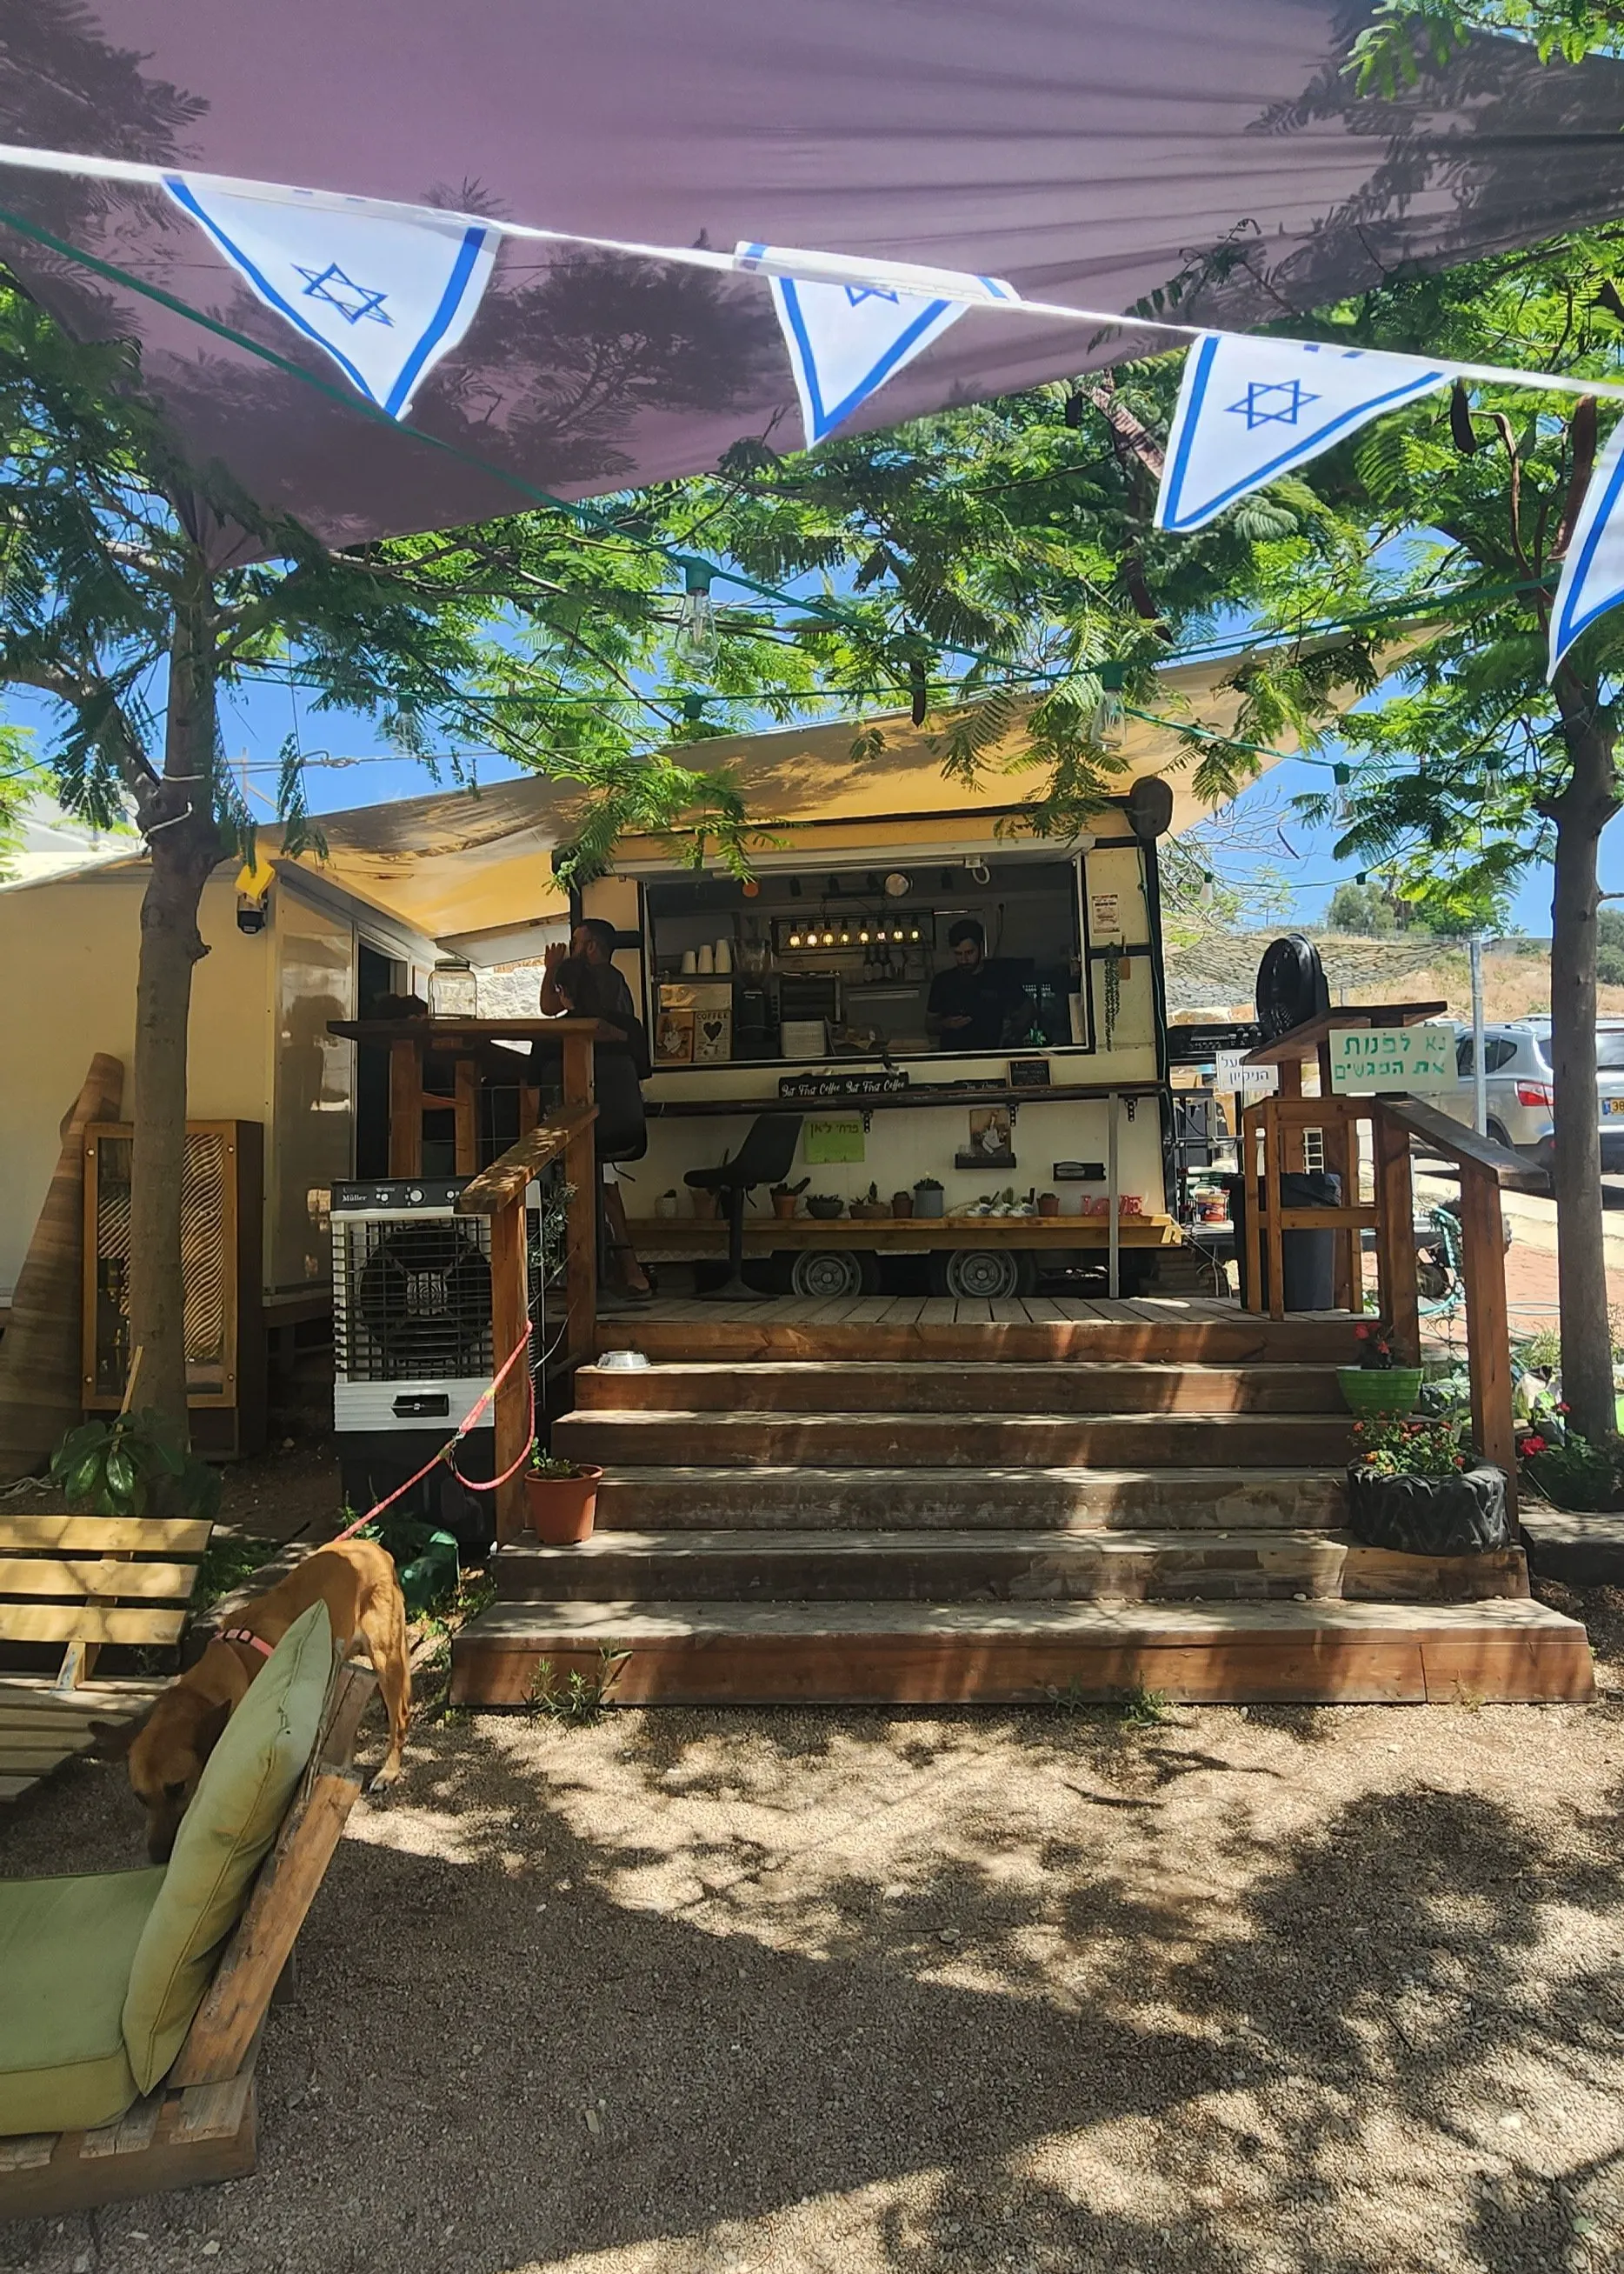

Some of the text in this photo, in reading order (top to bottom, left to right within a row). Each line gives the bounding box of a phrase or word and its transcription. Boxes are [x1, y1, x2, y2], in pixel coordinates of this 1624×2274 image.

[1344, 1032, 1447, 1055] נא לפנות
[1334, 1060, 1445, 1080] את המגשים
[798, 1084, 815, 1096] First
[819, 1082, 840, 1095] Coffee
[862, 1080, 881, 1092] First
[883, 1078, 905, 1092] Coffee
